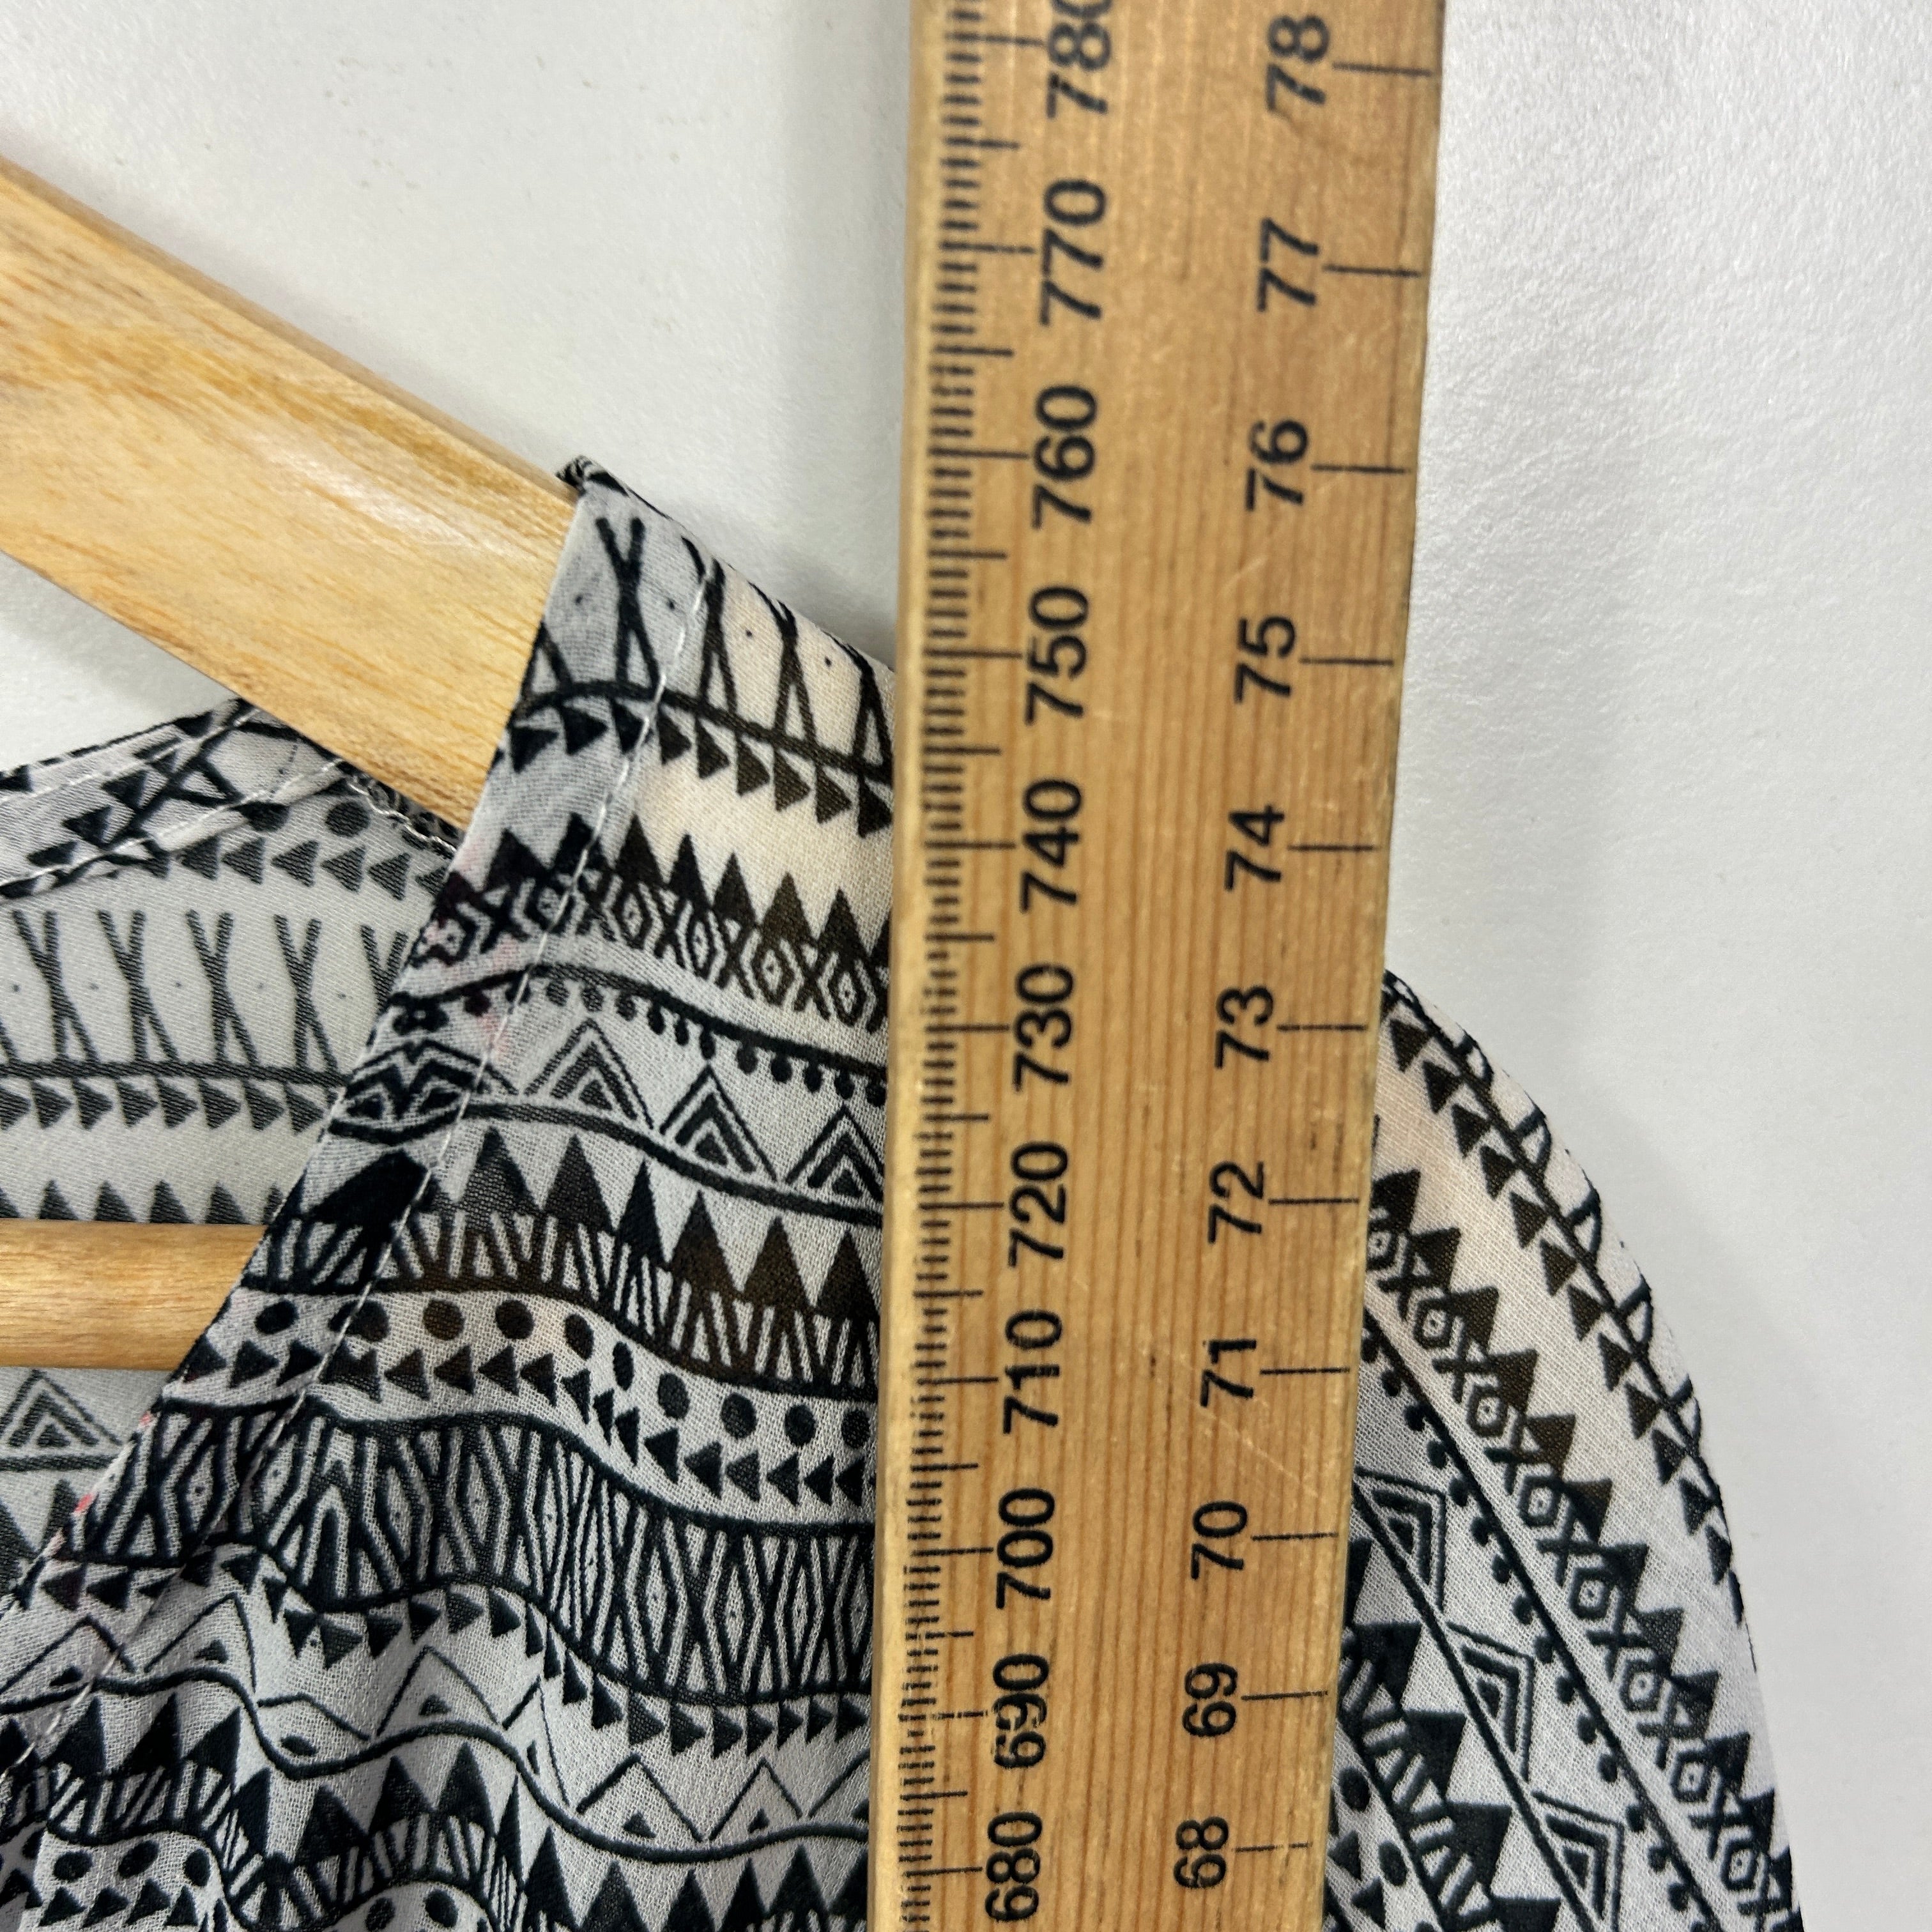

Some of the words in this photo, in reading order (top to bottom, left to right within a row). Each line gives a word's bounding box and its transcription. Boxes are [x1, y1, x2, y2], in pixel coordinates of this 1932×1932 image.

[1266, 15, 1330, 112] 78
[1039, 179, 1107, 326] 770
[1257, 217, 1319, 312] 77
[1032, 385, 1098, 529] 760
[1245, 419, 1309, 512] 76
[1025, 585, 1089, 726] 750
[1233, 615, 1297, 704] 75
[1020, 778, 1084, 913] 740
[1224, 804, 1285, 892] 74
[1012, 963, 1075, 1092] 730
[1214, 985, 1275, 1070] 73
[1008, 1141, 1069, 1268] 720
[1208, 1161, 1265, 1245] 72
[1002, 1309, 1064, 1435] 710
[1199, 1338, 1257, 1408] 71
[995, 1487, 1055, 1611] 700
[1190, 1500, 1249, 1581] 70
[992, 1653, 1052, 1771] 690
[1181, 1662, 1238, 1740] 69
[985, 1811, 1043, 1924] 680
[1173, 1816, 1229, 1891] 68
